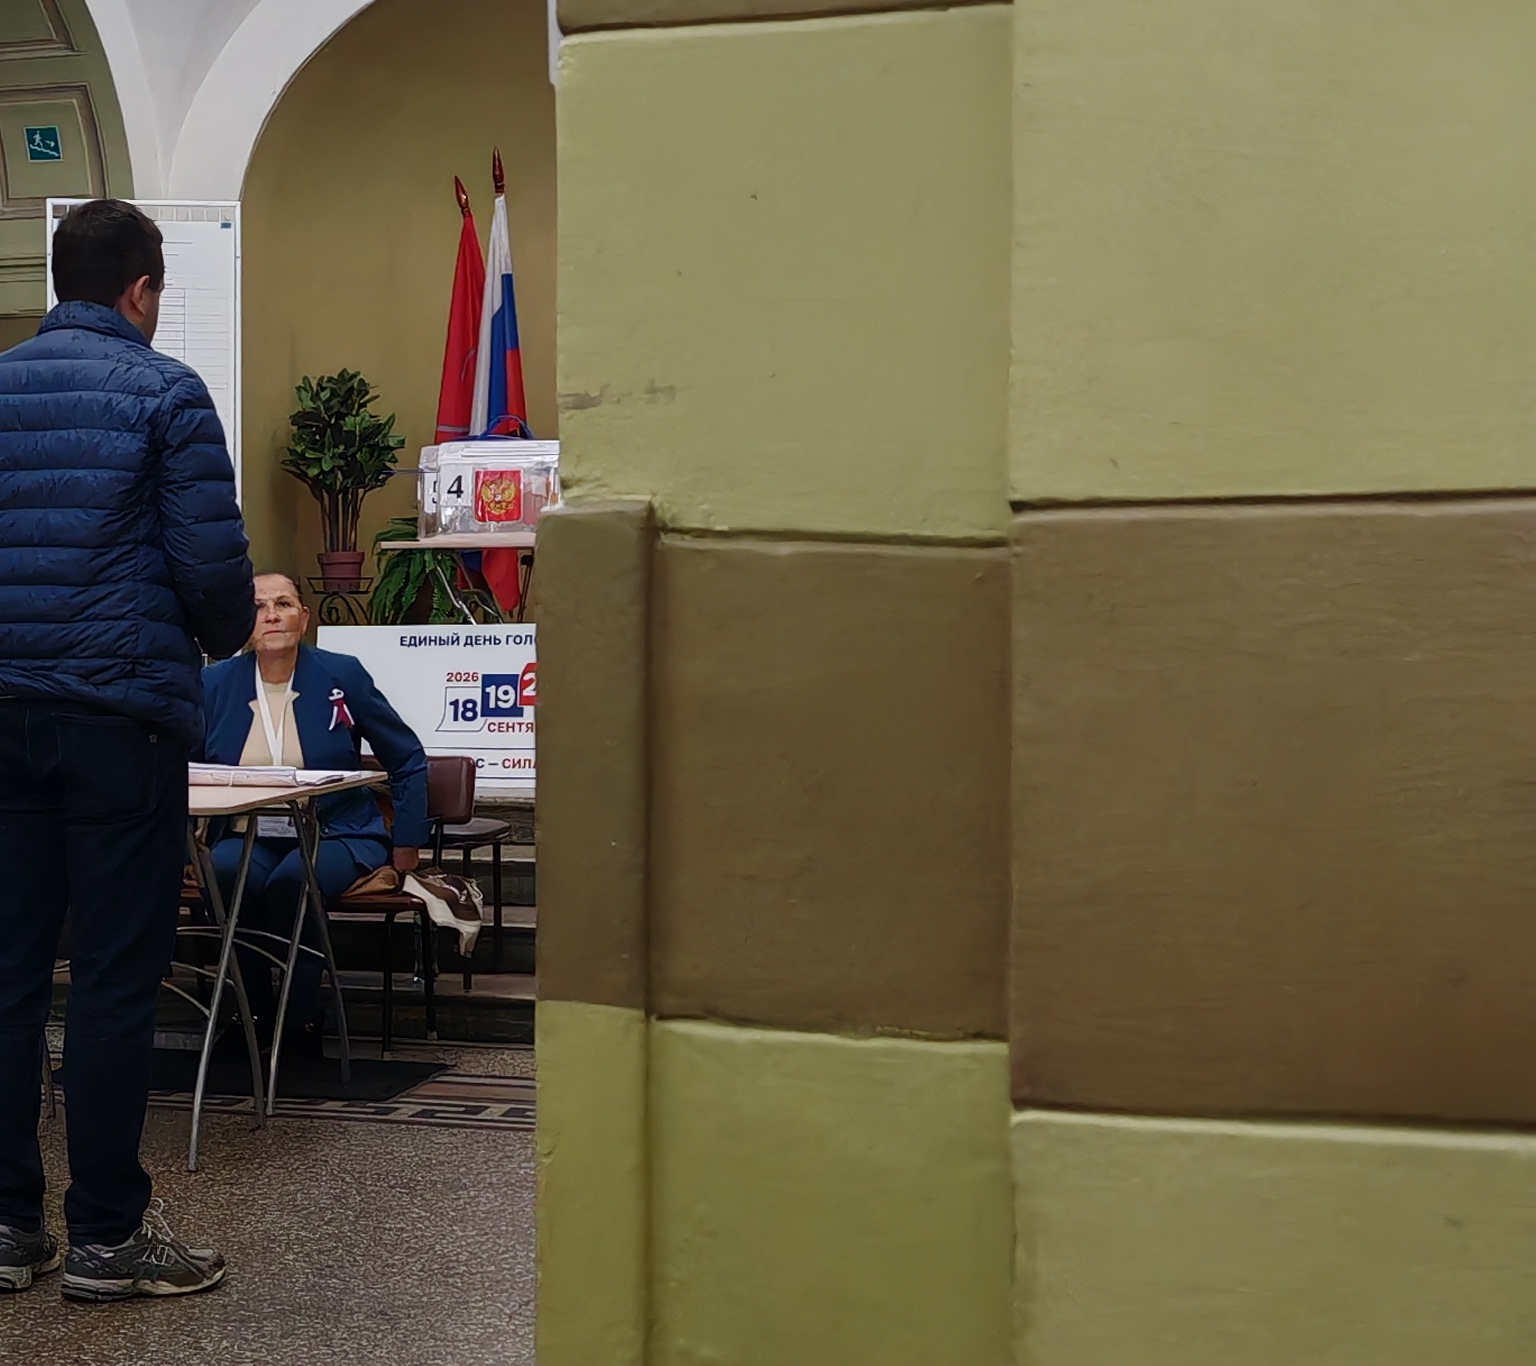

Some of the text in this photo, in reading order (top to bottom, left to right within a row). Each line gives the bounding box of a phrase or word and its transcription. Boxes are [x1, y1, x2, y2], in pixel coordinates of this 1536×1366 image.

[447, 475, 464, 499] 4
[399, 632, 536, 648] ЕДИНЫЙ ДЕНЬ ГОЛ
[446, 671, 479, 683] 2026
[449, 698, 479, 722] 18
[485, 684, 516, 709] 19
